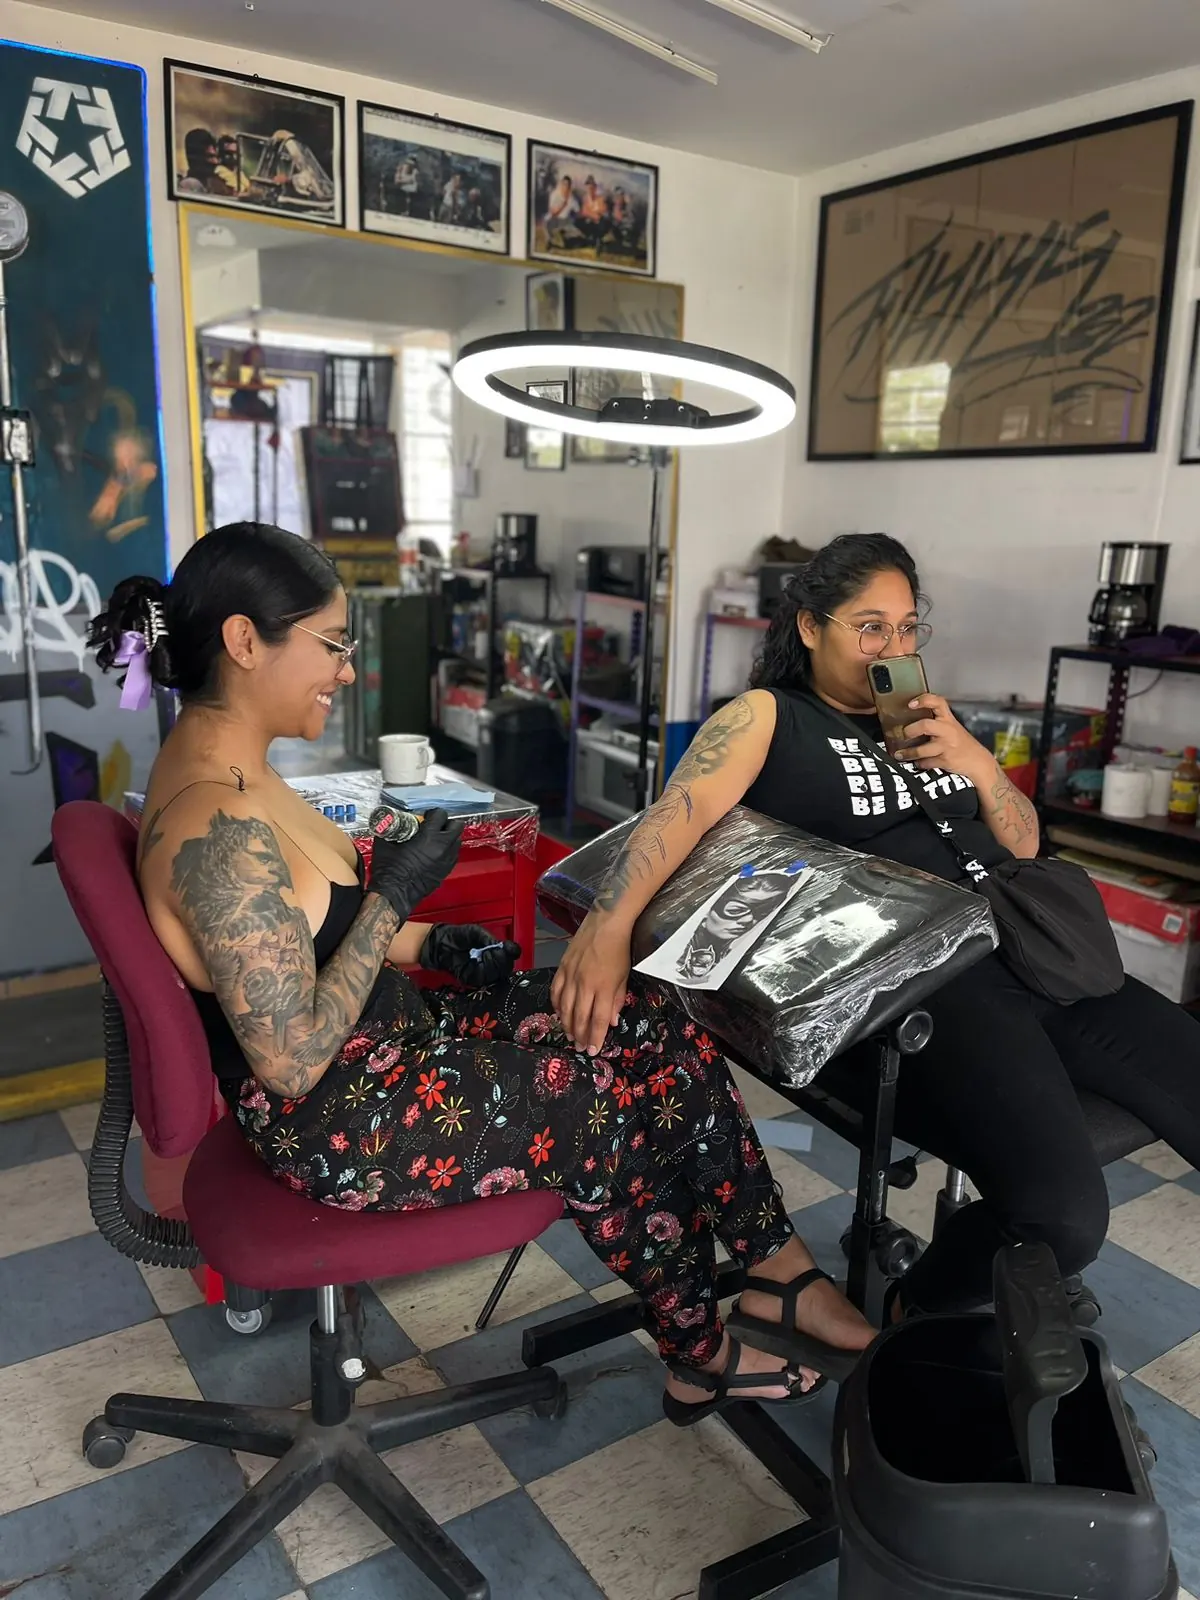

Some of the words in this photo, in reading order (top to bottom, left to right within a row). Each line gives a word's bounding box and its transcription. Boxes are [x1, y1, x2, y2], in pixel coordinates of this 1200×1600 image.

[827, 737, 861, 753] BE
[840, 757, 879, 773] BE
[847, 774, 884, 793] BE
[851, 795, 887, 816] BE
